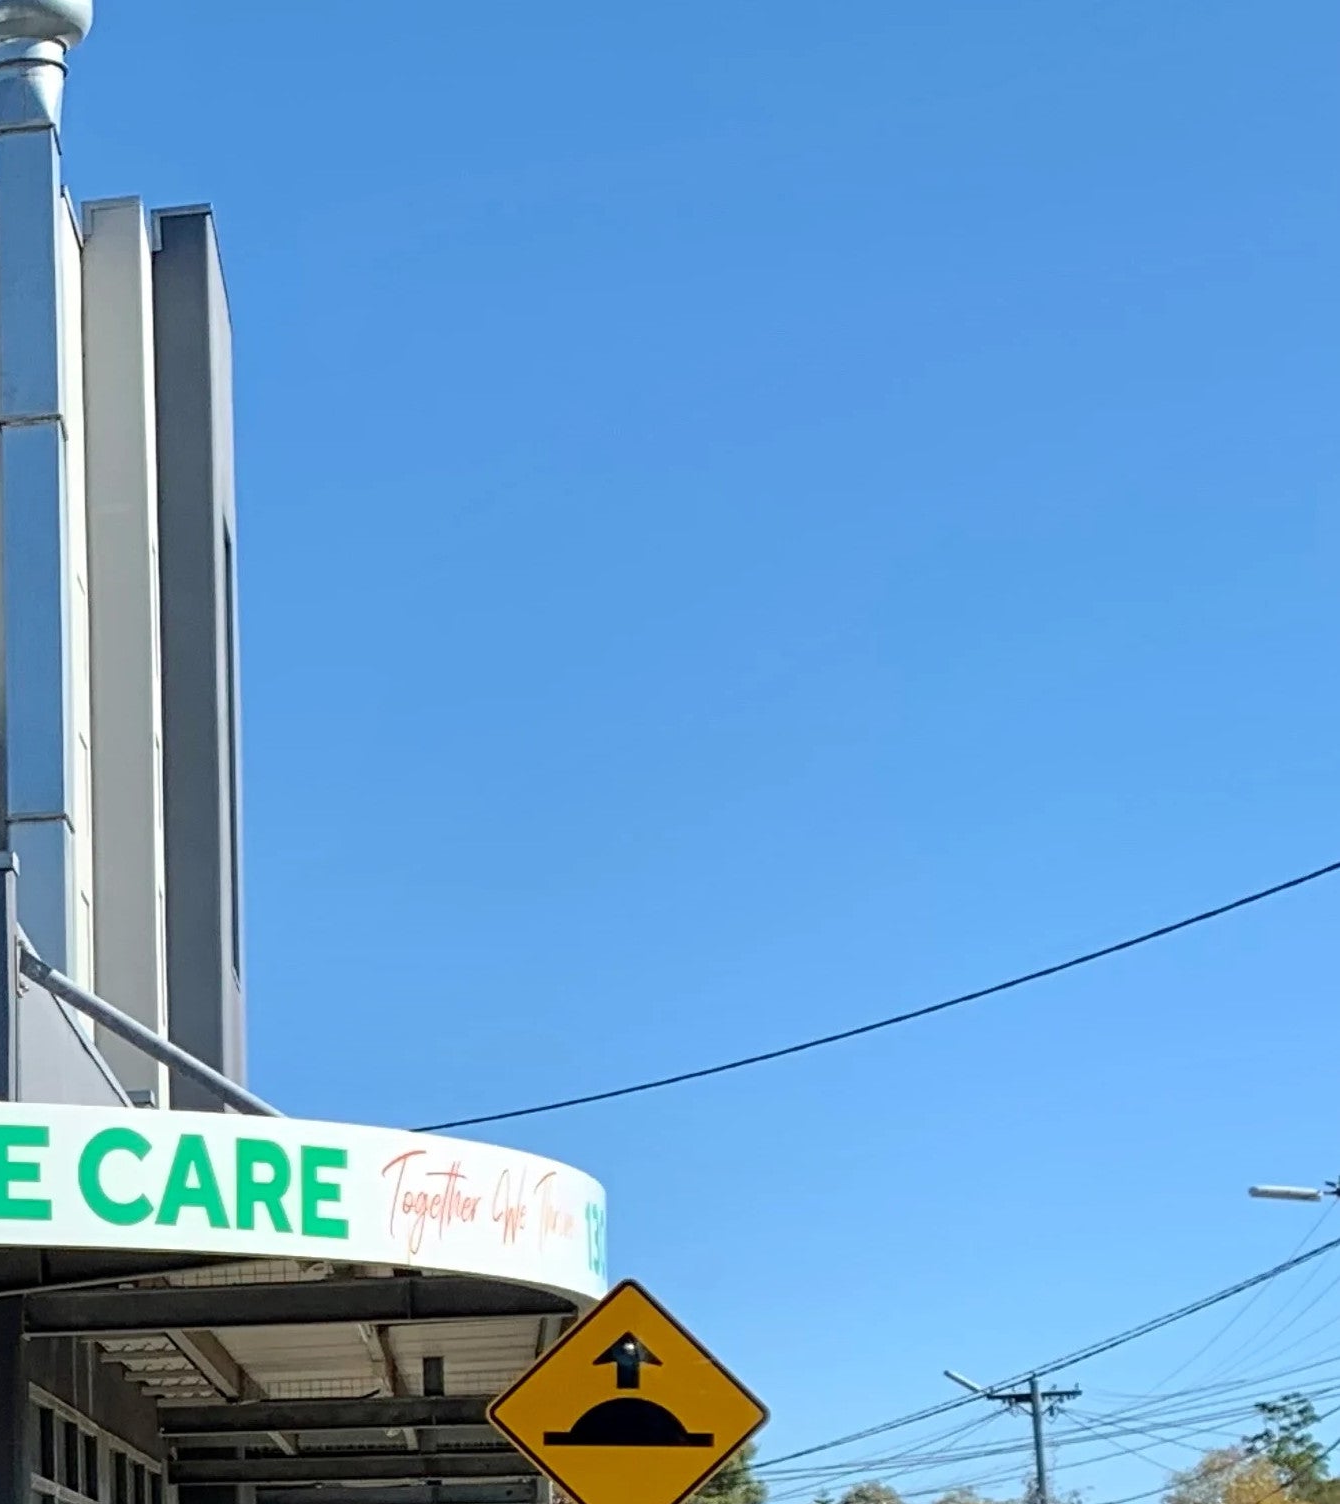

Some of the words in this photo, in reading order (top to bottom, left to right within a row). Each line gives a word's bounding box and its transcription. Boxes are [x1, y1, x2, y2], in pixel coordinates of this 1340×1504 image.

[78, 1127, 349, 1239] CARE
[381, 1150, 481, 1254] Together
[492, 1164, 528, 1244] We
